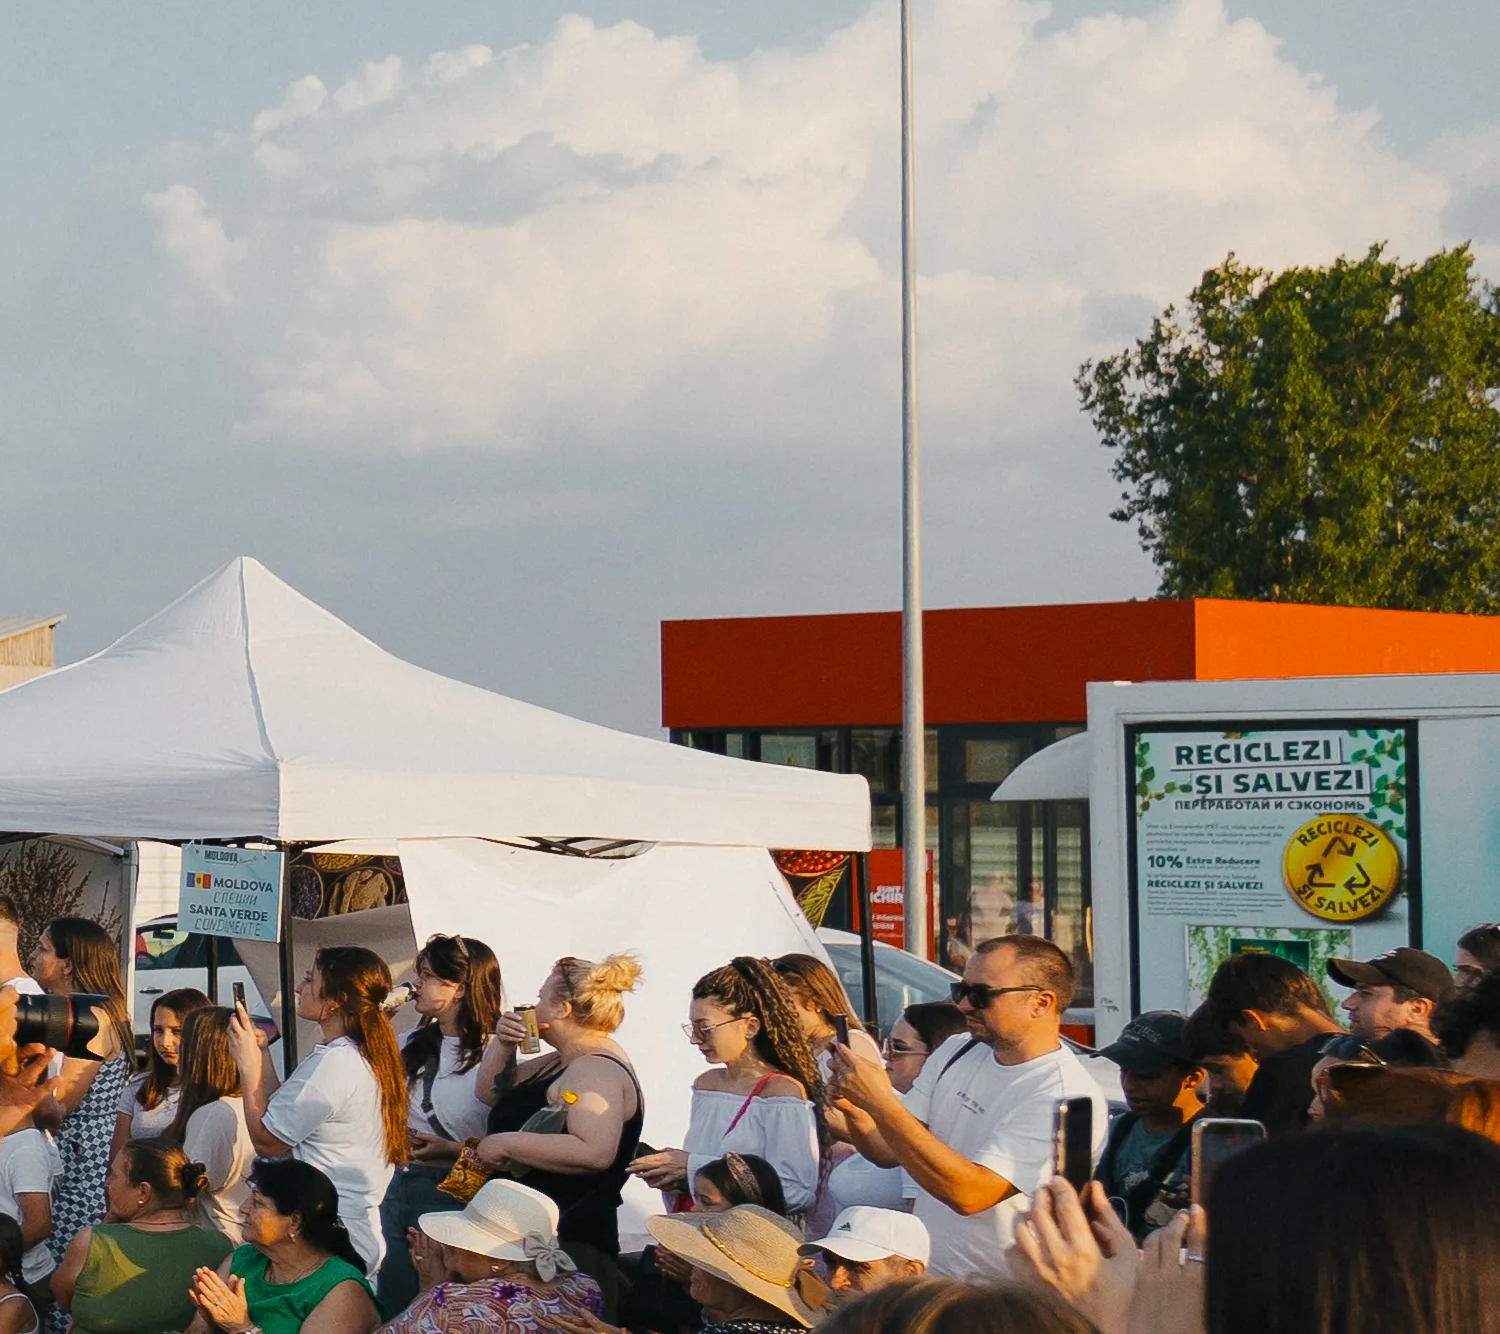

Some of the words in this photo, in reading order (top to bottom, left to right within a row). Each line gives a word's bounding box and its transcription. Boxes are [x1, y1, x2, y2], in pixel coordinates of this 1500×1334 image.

[1175, 740, 1331, 766] RECICLEZI
[1233, 769, 1364, 794] SALVEZI
[1175, 798, 1271, 811] ПЕРЕРАБОТАЙ
[1274, 801, 1283, 810] И
[1297, 821, 1379, 847] RECICLEZI
[204, 850, 238, 862] MOLDOVA
[1147, 855, 1183, 868] 10%
[1186, 856, 1212, 865] Extra
[1215, 856, 1261, 865] Reducere
[214, 877, 274, 893] MOLDOVA
[1147, 880, 1201, 888] RECICLEZI
[1217, 881, 1263, 890] SALVEZI
[1314, 884, 1385, 914] SALVEZI
[189, 903, 227, 917] SANTA
[229, 908, 268, 922] VERDE
